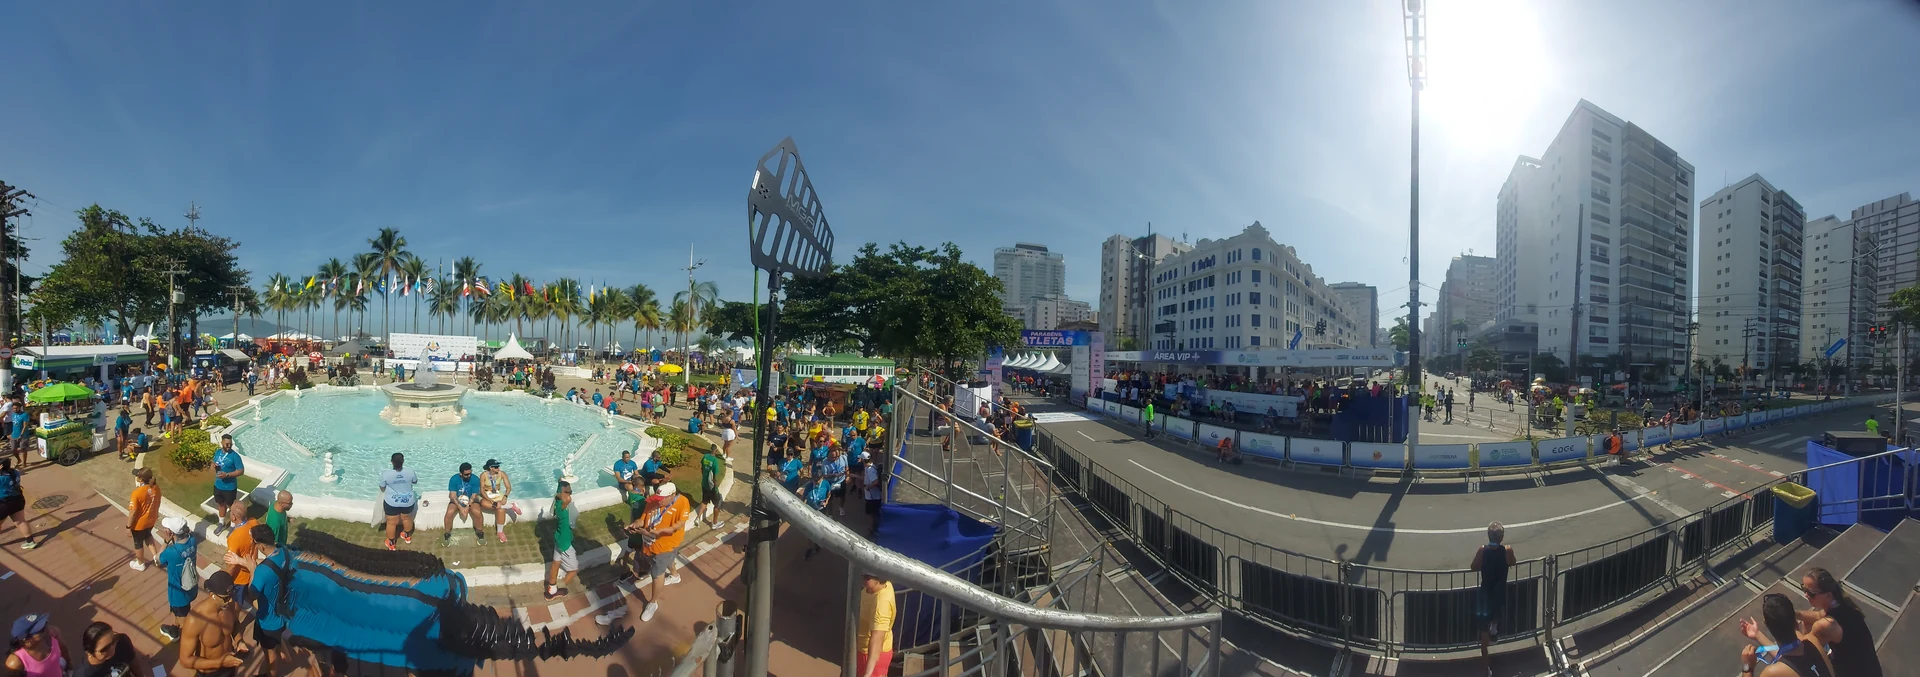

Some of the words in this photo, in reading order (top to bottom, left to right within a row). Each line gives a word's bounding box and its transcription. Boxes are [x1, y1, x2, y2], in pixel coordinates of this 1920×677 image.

[788, 194, 815, 229] MGA
[1021, 336, 1073, 345] ATLETAS
[1153, 351, 1175, 361] ÁREA
[1177, 352, 1191, 361] VIP
[1552, 444, 1575, 454] EDGE
